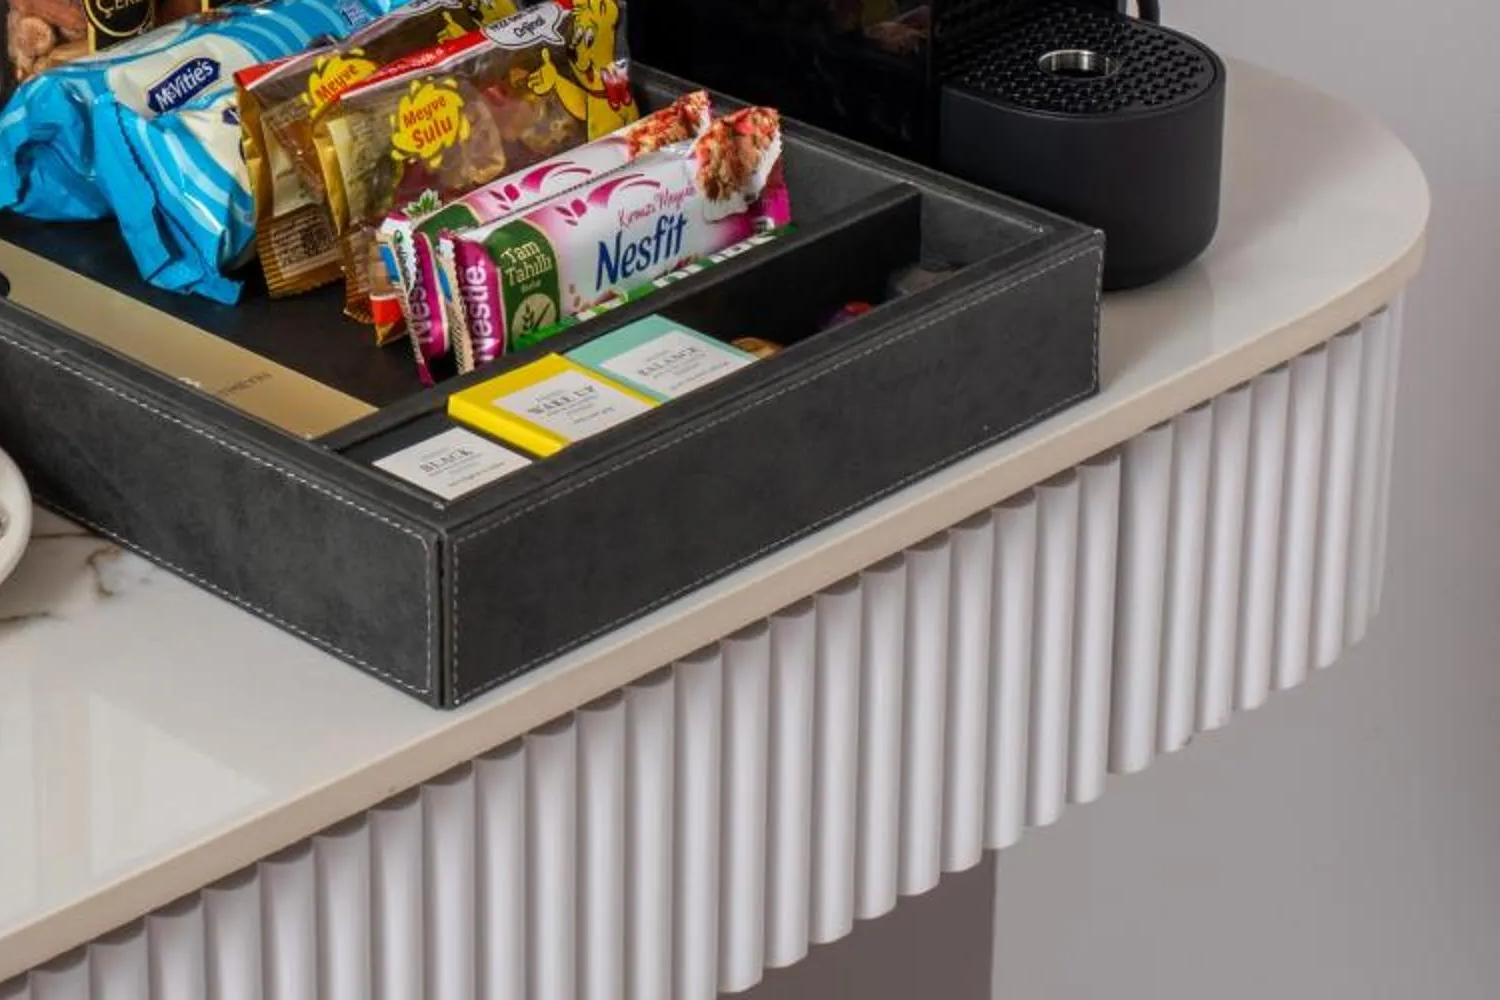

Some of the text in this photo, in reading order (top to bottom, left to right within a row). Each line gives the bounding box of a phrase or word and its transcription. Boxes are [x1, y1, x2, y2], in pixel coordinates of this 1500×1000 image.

[403, 95, 447, 129] Meyve
[411, 116, 453, 149] Sulu
[501, 241, 541, 264] Tam
[595, 212, 688, 292] Nesfit
